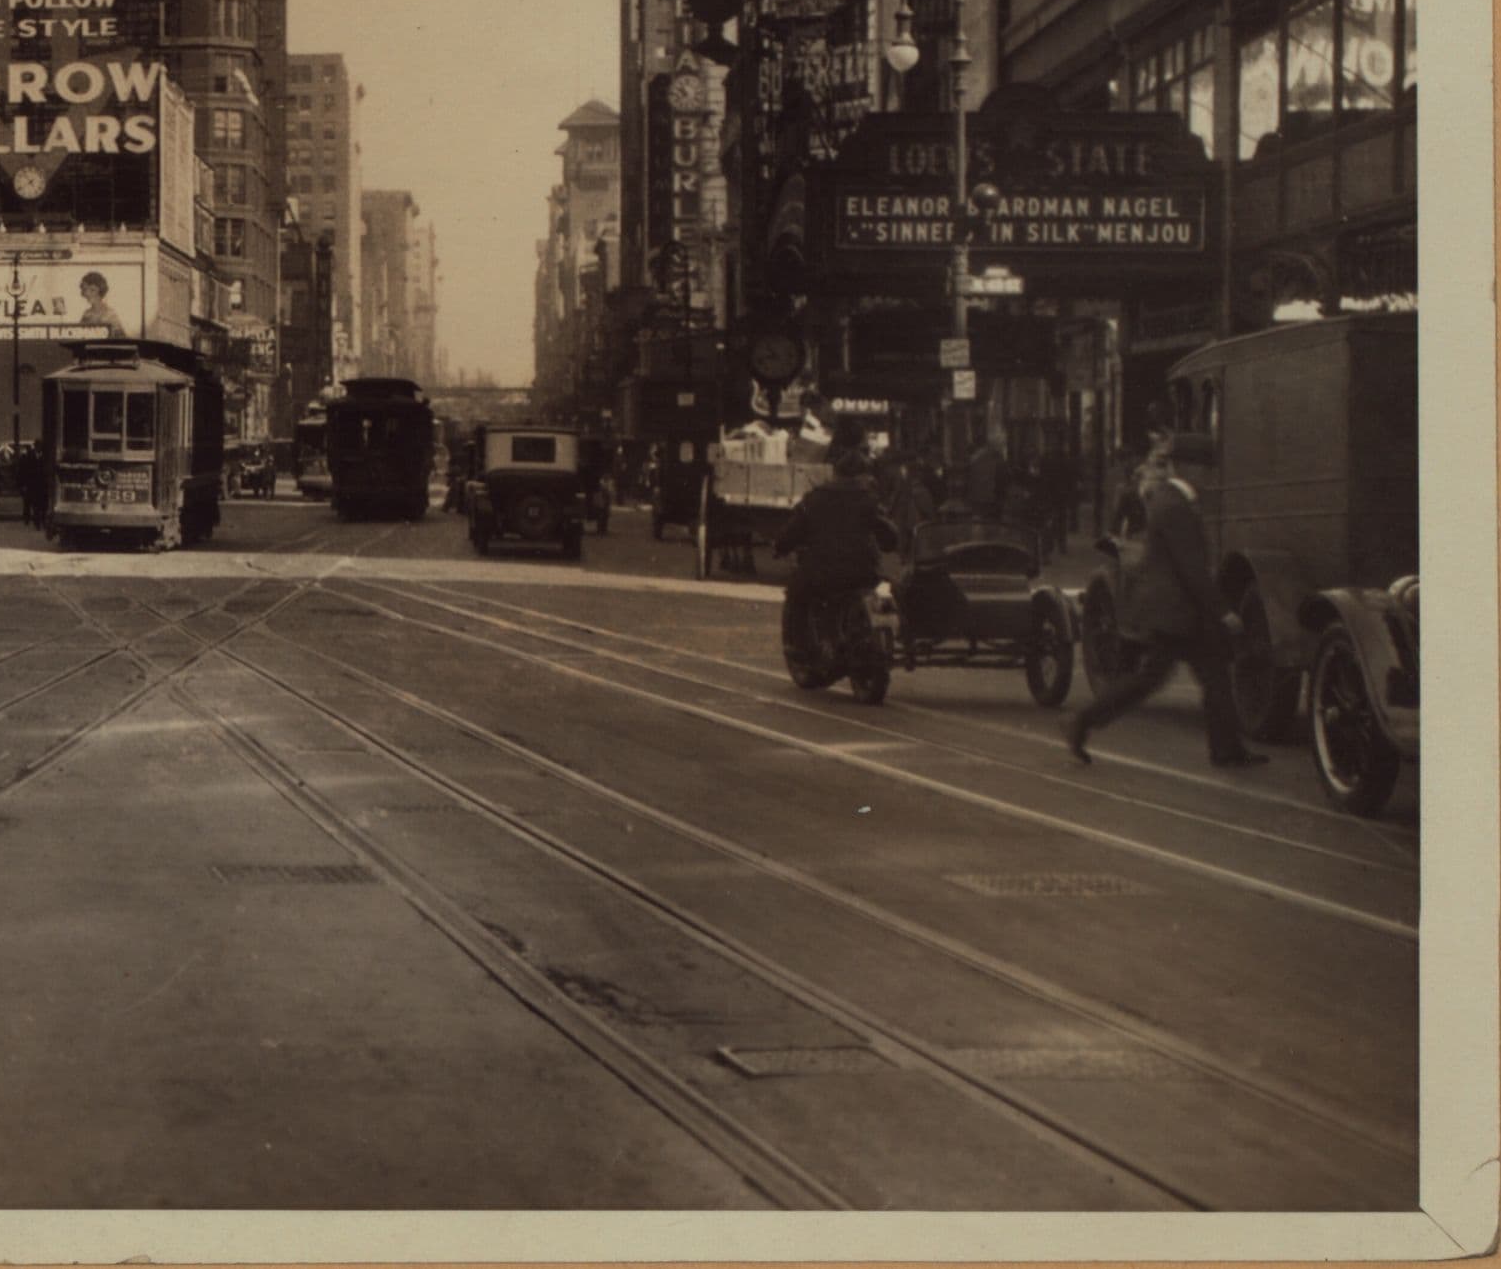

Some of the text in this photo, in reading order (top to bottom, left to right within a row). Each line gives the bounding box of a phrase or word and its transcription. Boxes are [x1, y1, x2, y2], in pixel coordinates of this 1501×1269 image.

[17, 17, 118, 38] STYLE
[1047, 141, 1153, 177] STATE
[845, 196, 1179, 219] ELEANOR BARDMAN NAGEL
[991, 222, 1014, 243] IN
[1096, 222, 1191, 244] MENJOU
